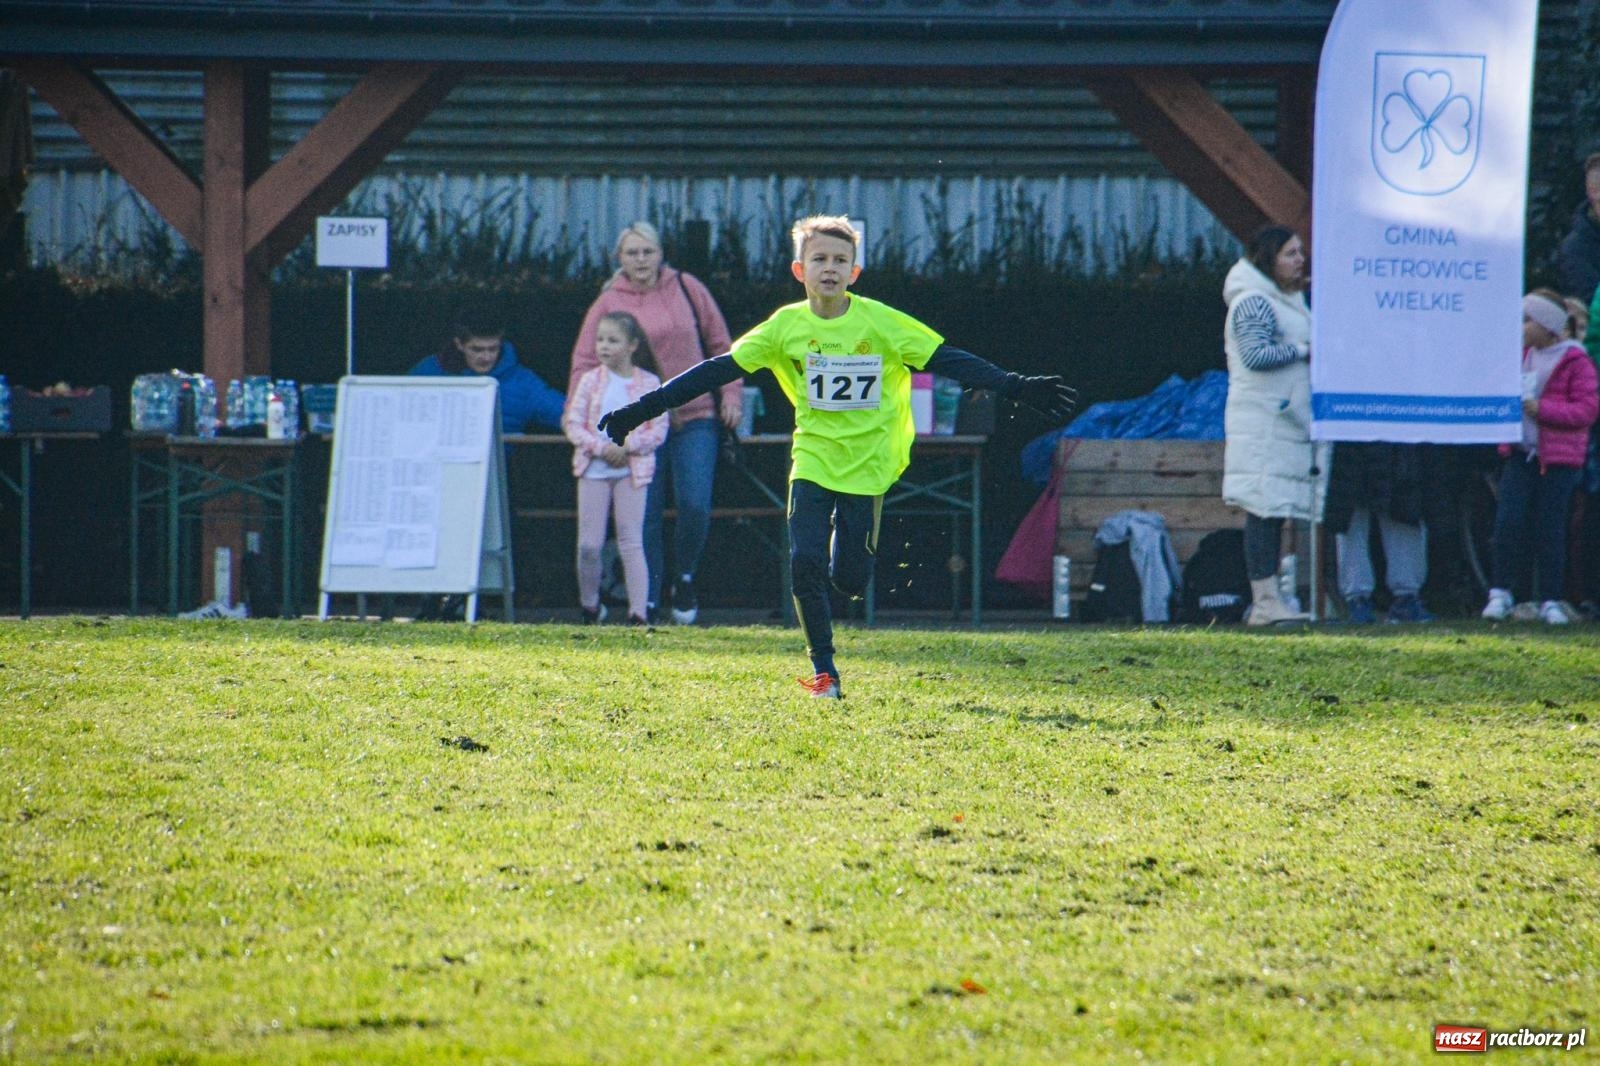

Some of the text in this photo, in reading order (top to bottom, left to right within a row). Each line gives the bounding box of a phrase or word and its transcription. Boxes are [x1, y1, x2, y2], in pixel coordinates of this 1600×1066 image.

[327, 223, 378, 237] ZAPISY
[1384, 225, 1458, 246] GMINA
[1353, 257, 1488, 281] PIETROWICE
[1375, 290, 1465, 312] WIELKIE
[810, 374, 878, 401] 127
